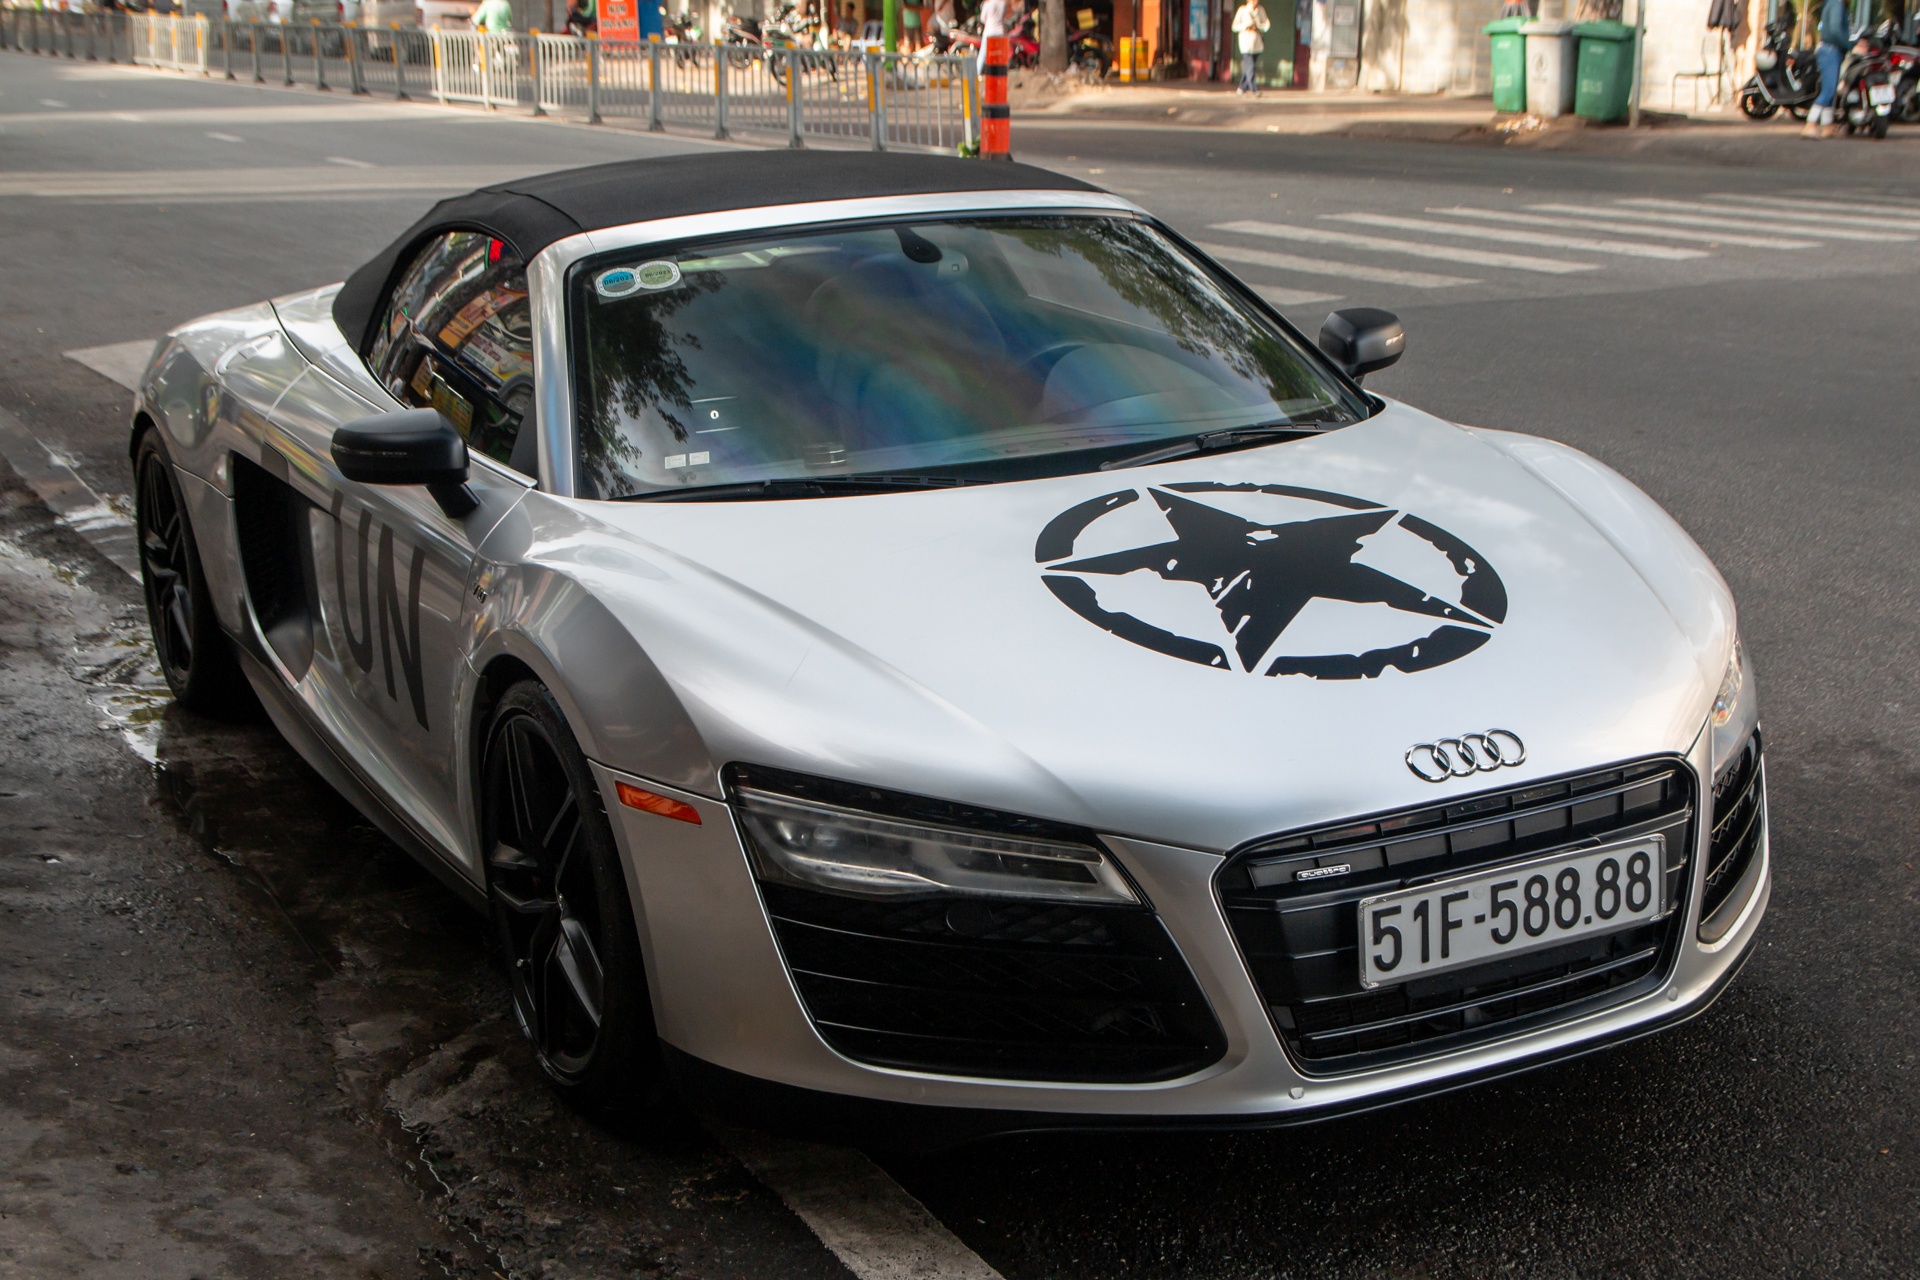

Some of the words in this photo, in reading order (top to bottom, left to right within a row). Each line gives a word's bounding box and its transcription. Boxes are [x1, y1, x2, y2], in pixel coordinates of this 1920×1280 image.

[331, 488, 429, 732] UN
[1301, 866, 1347, 878] quattro
[1372, 850, 1652, 972] 51F-588.88
